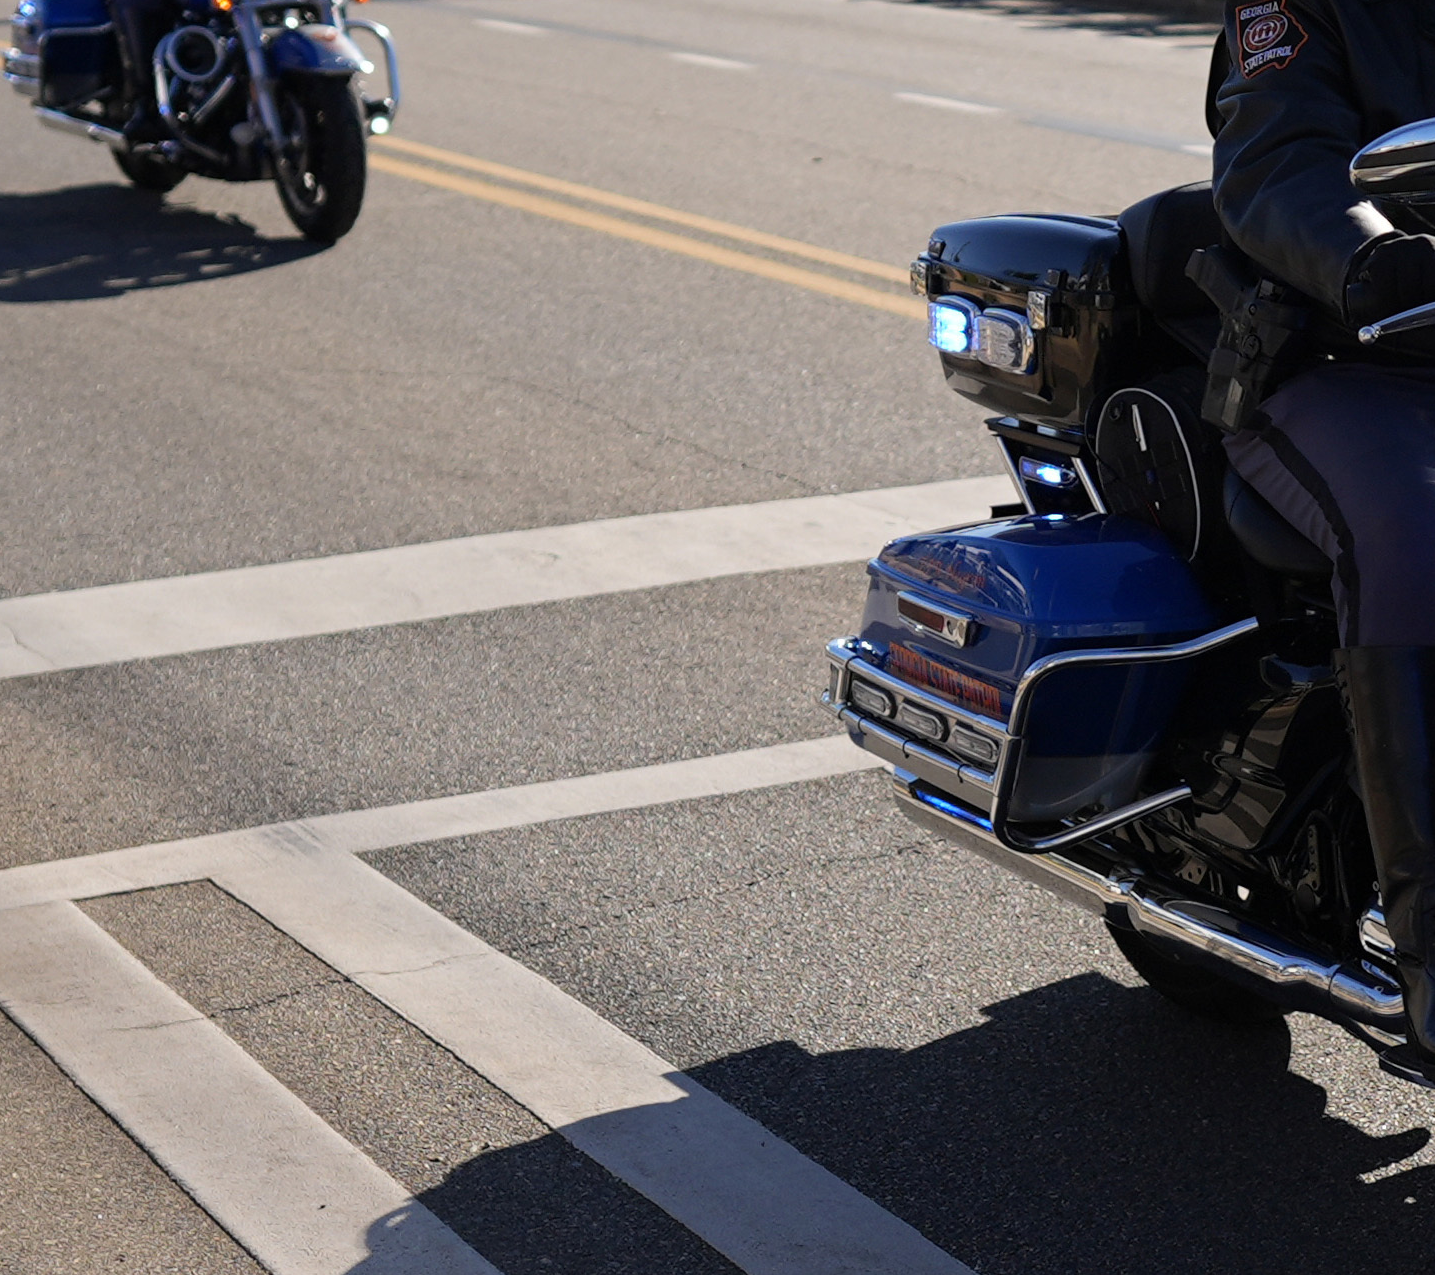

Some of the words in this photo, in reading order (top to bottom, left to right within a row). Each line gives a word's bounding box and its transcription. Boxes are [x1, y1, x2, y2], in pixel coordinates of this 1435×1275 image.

[1240, 0, 1280, 21] GEORGIA
[1244, 52, 1265, 73] STATE
[1263, 45, 1293, 64] PATROL
